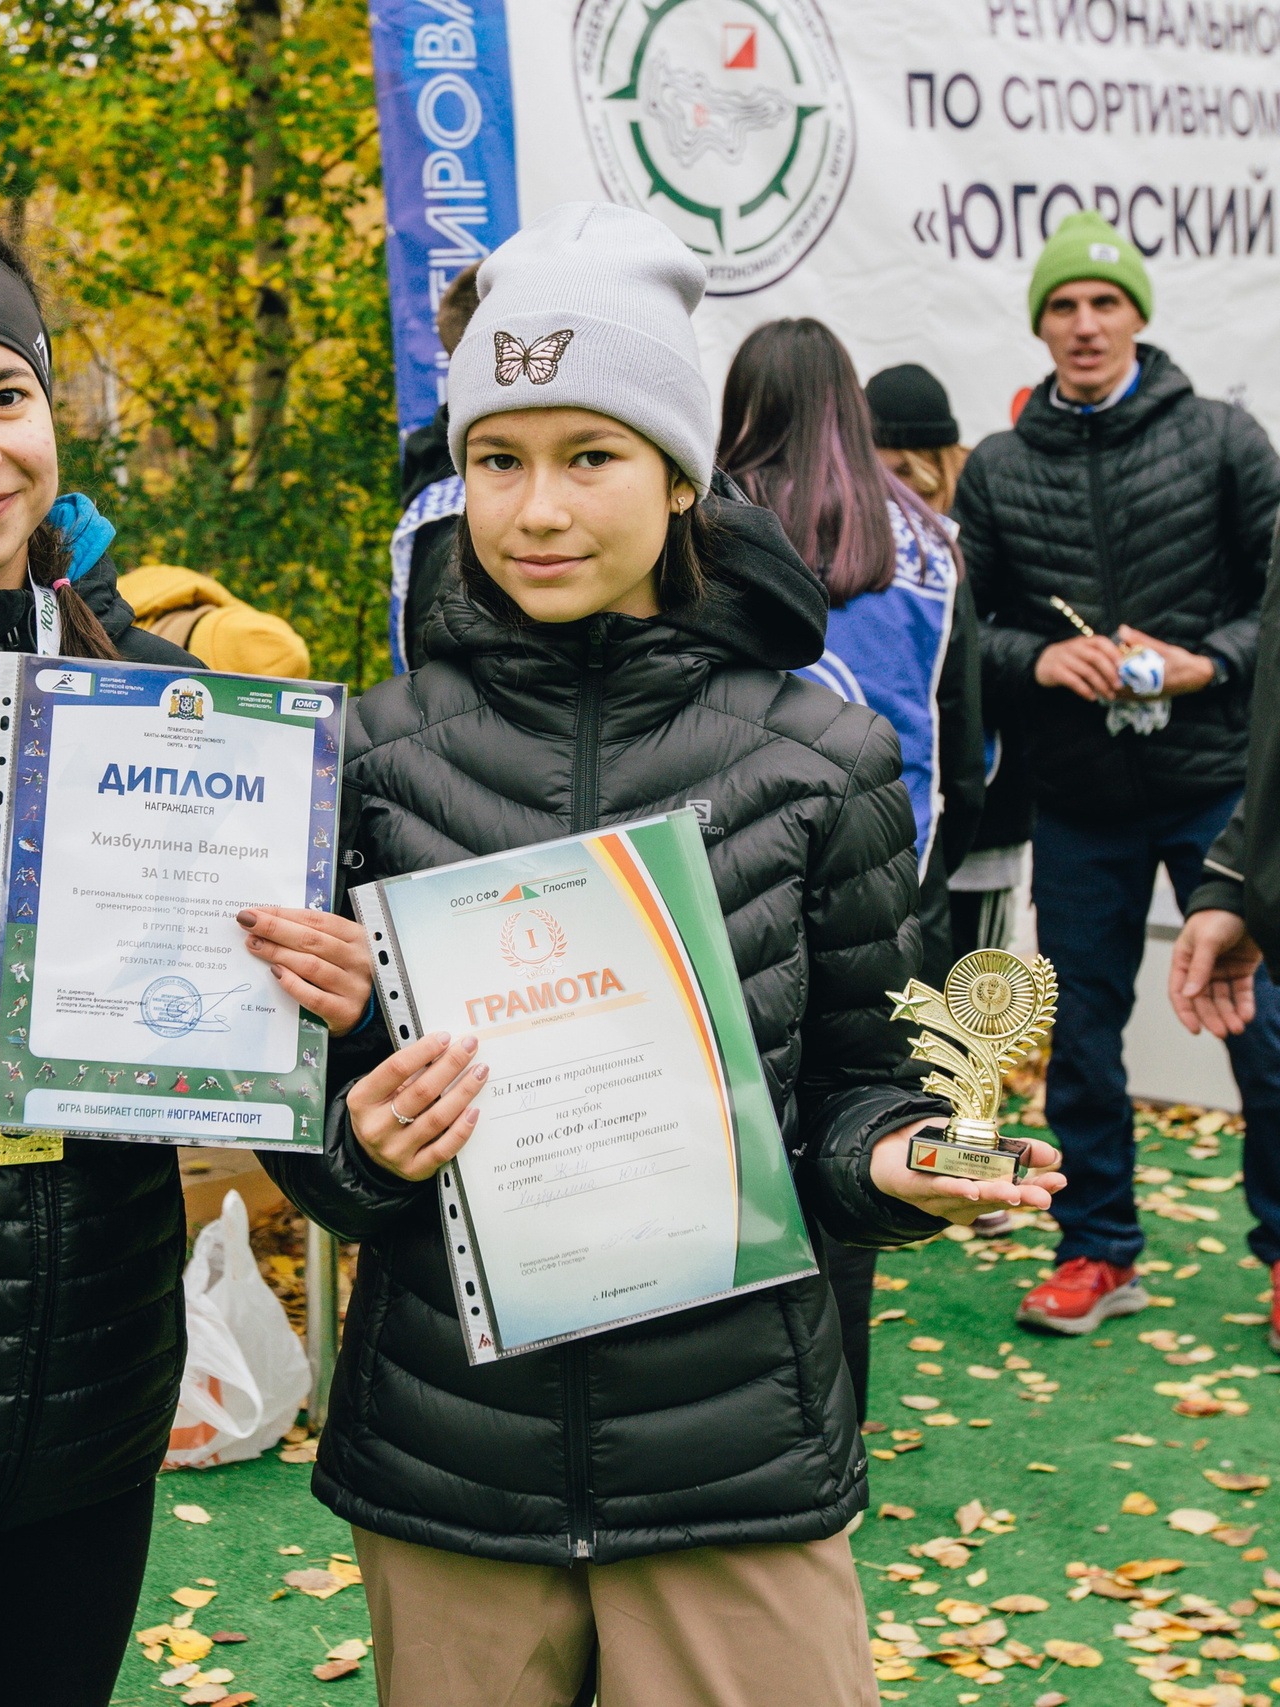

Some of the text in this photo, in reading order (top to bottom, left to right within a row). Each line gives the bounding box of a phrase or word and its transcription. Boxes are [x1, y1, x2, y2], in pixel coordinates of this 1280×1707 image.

[907, 72, 981, 129] ПО
[296, 700, 318, 708] ЮМС
[98, 763, 265, 802] ДИПЛОМ
[145, 801, 214, 815] НАГРАЖДАЕТСЯ
[91, 832, 268, 859] Хизбуллина Валерия
[142, 867, 219, 883] ЗА 1 МЕСТО
[542, 877, 587, 894] Глостер
[80, 889, 142, 900] региональных
[145, 894, 210, 905] соревнованиях
[450, 890, 499, 908] ООО СФФ
[96, 902, 238, 918] ориентированию "Югорский Ази
[143, 922, 208, 934] В ГРУППЕ: Ж-21
[117, 940, 232, 954] ДИСЦИПЛИНА: КРОСС-ВЫБОР
[525, 929, 539, 949] I
[120, 956, 165, 966] РЕЗУЛЬТАТ:
[195, 962, 227, 970] 00:32:05
[465, 968, 624, 1026] ГРАМОТА
[241, 1004, 276, 1014] С.Е. Конух
[531, 1011, 575, 1026] НАГРАЖДАЕТСЯ
[491, 1086, 504, 1098] За
[507, 1084, 511, 1094] I
[515, 1077, 552, 1092] место
[563, 1054, 644, 1082] традиционных
[584, 1068, 663, 1096] соревнованиях
[57, 1103, 262, 1124] ЮГРА ВЫБИРАЕТ СПОРТ! #ЮГРАМЕГАСПОРТ
[556, 1101, 602, 1120] на кубок
[516, 1110, 647, 1148] ООО «СФФ «Глостер»
[493, 1121, 679, 1173] по спортивному ориентированию
[963, 1153, 990, 1164] МЕСТО
[498, 1172, 543, 1192] в группе
[519, 1246, 589, 1269] Генеральный директор
[521, 1267, 537, 1276] ООО
[601, 1278, 659, 1300] Нефтеюганск
